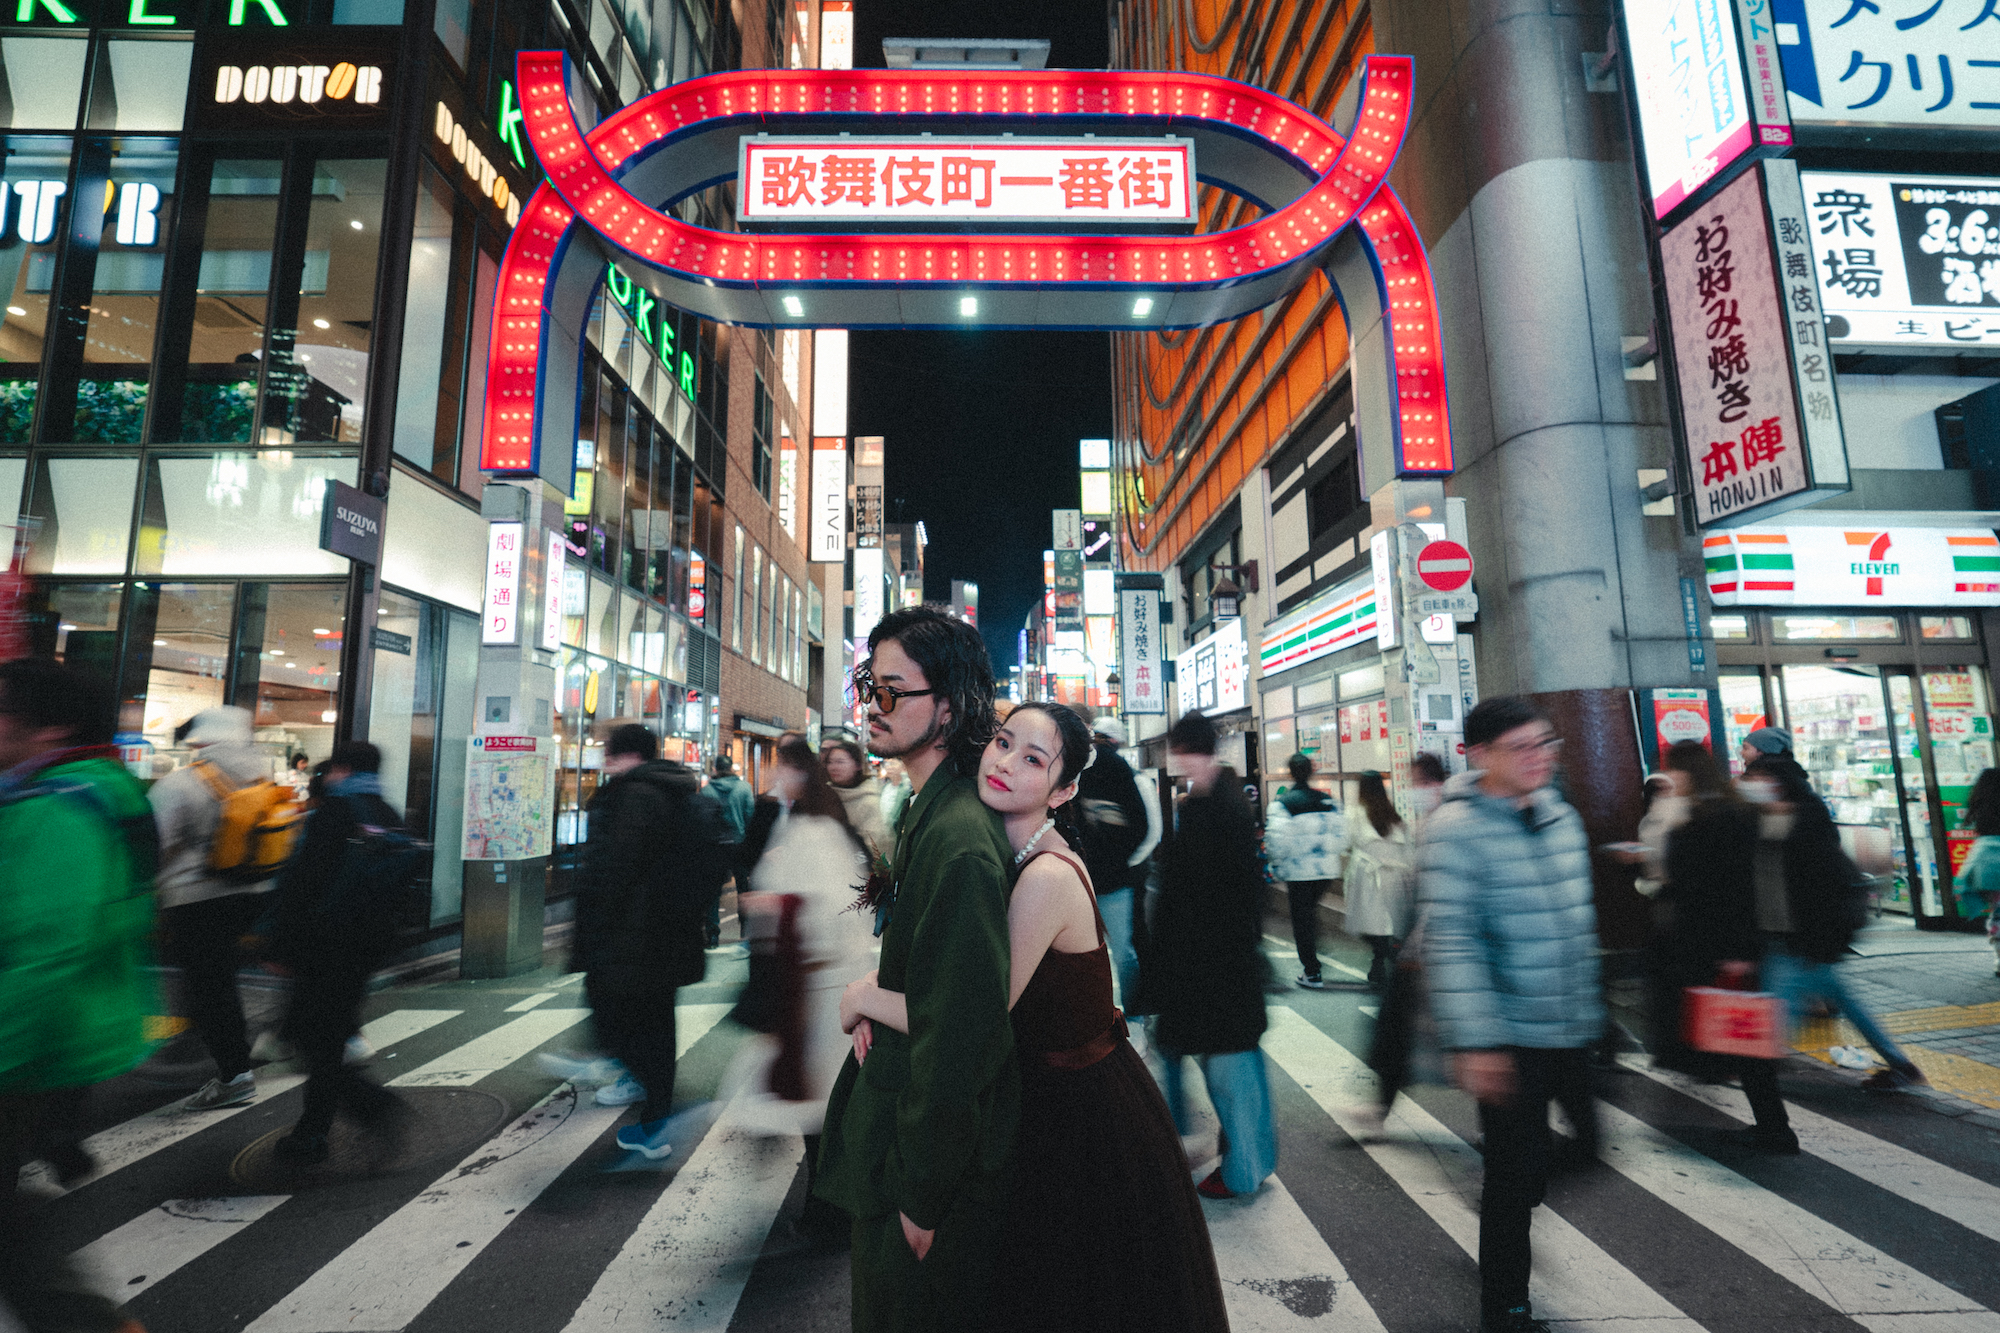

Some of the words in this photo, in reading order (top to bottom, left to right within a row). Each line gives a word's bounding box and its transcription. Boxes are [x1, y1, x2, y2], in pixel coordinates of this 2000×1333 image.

[215, 62, 382, 104] DOUTOR
[434, 101, 521, 228] DOUTOR
[762, 155, 1173, 209] 歌舞伎町一番街
[1694, 214, 1751, 423] お好み焼き
[1779, 217, 1833, 421] 歌舞伎町名物
[1700, 416, 1787, 487] 本陣
[1709, 466, 1784, 515] HONJIN
[335, 506, 378, 534] SUZUYA
[826, 493, 840, 551] LIVE
[493, 533, 515, 633] 劇場通り
[1844, 531, 1892, 595] 7
[1133, 594, 1148, 662] お好み焼き
[1423, 597, 1474, 612] 自転車を除く
[1928, 674, 1972, 686] ATM
[1928, 716, 1966, 734] たばこ
